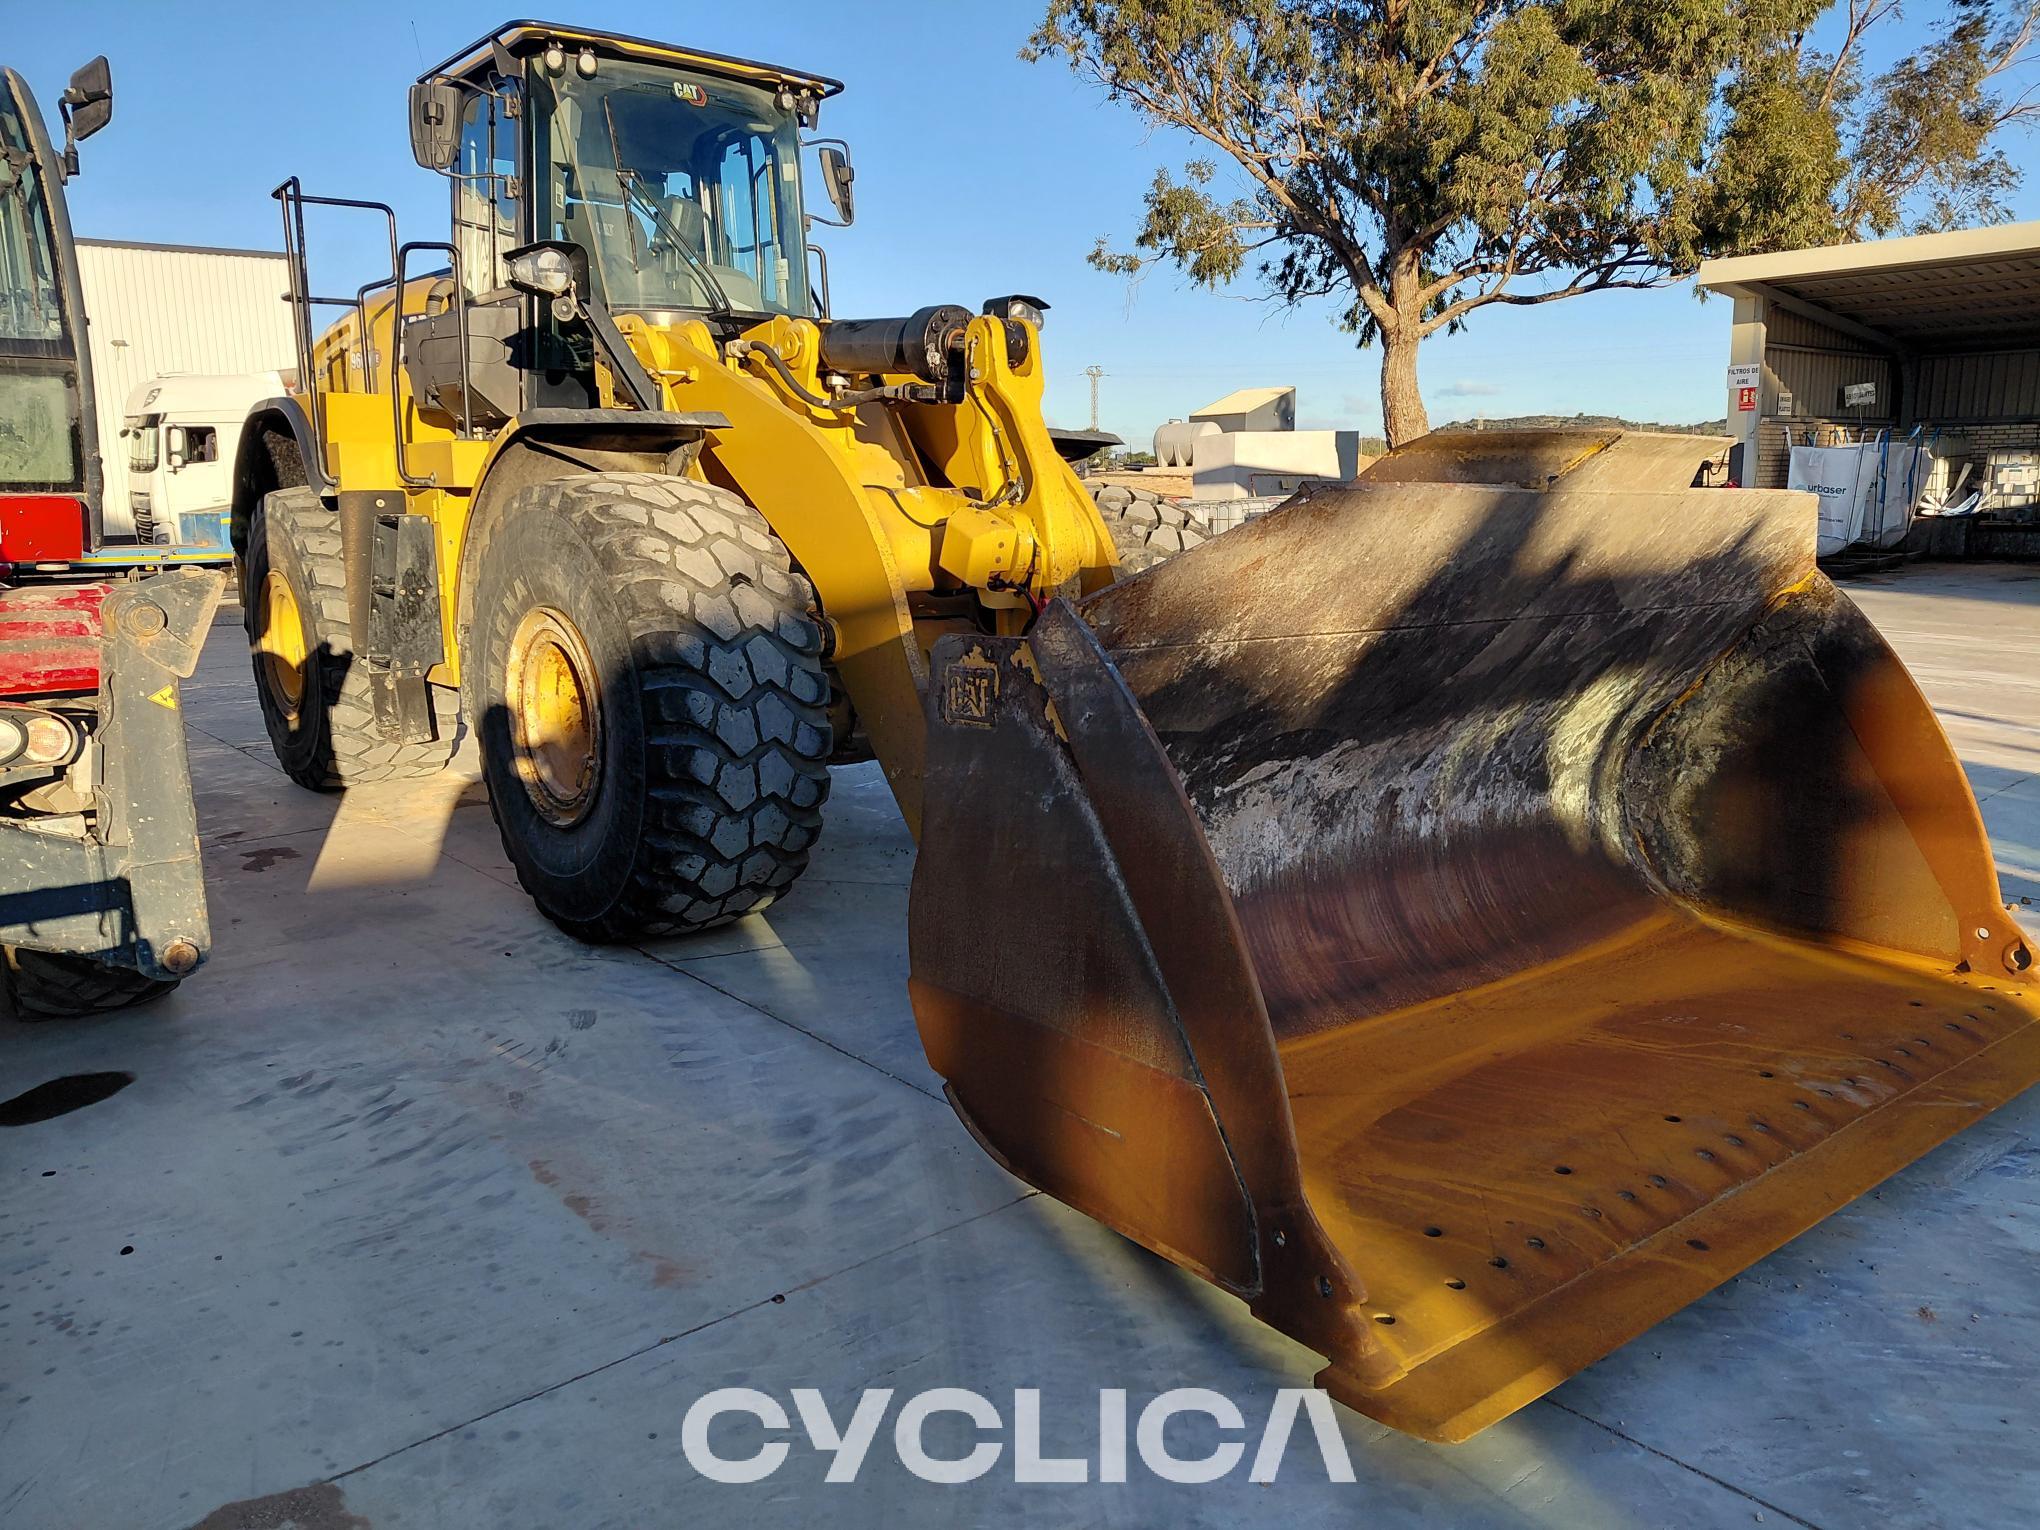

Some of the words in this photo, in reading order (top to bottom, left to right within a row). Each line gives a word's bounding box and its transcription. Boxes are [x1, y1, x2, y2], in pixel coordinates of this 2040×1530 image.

[673, 82, 698, 101] CAT
[1728, 367, 1750, 376] FILTROS
[1807, 483, 1847, 495] urbaser
